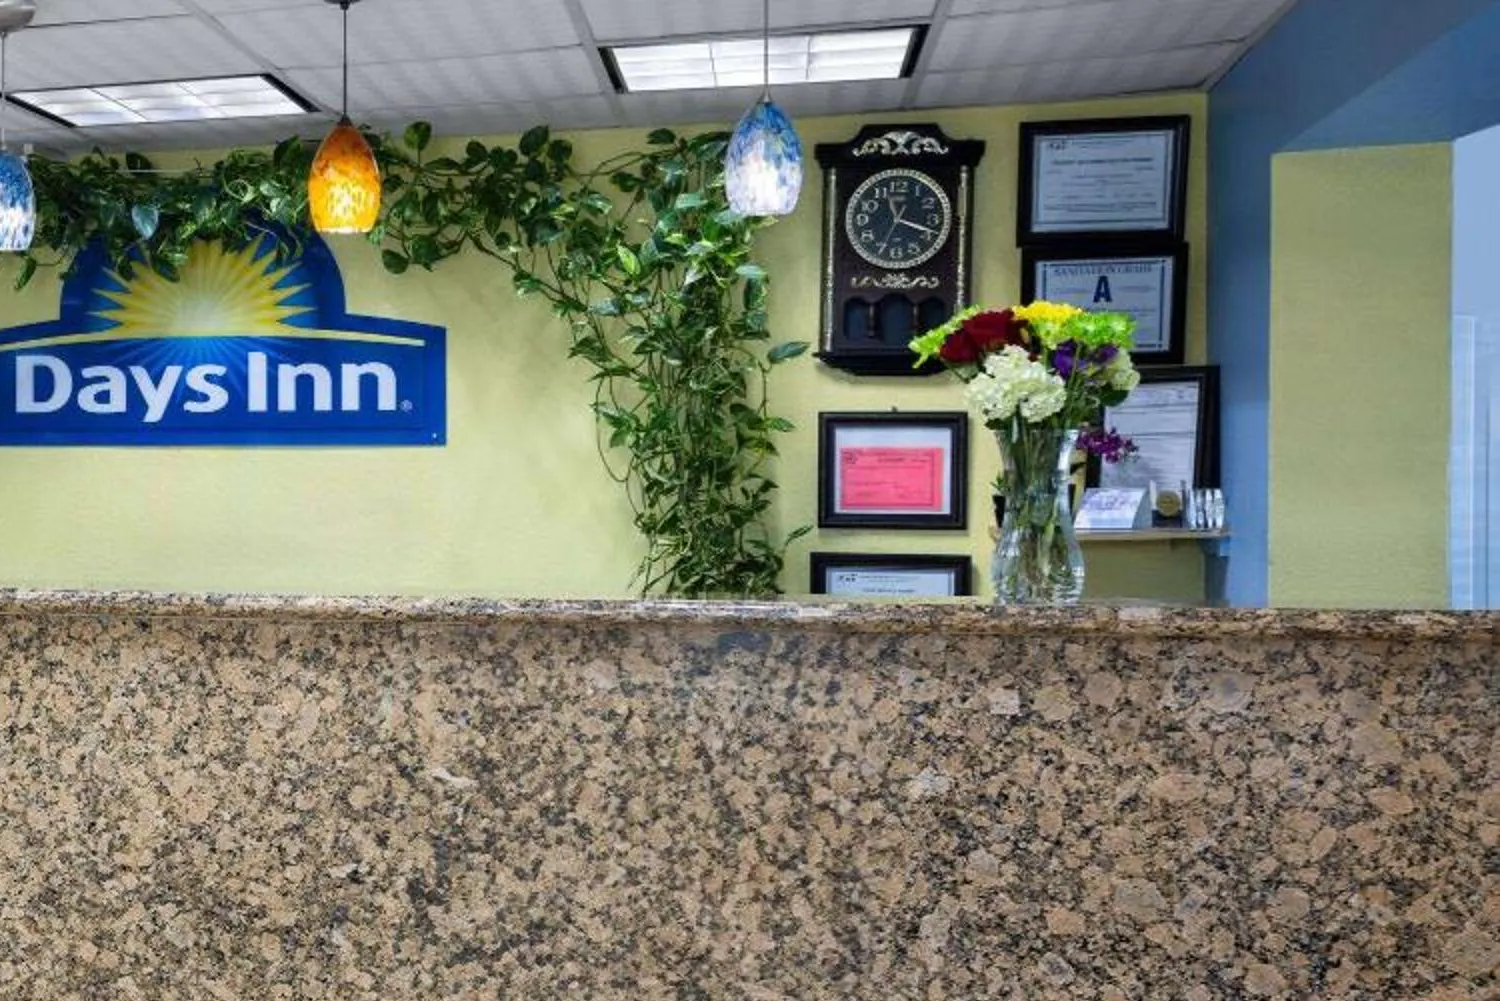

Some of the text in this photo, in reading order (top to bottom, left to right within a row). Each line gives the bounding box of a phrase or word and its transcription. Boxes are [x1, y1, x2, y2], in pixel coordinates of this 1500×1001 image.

[875, 186, 888, 199] 11
[889, 181, 908, 193] 12
[915, 184, 921, 197] 1
[861, 199, 880, 214] 10
[1092, 275, 1113, 303] A
[15, 354, 229, 423] Days
